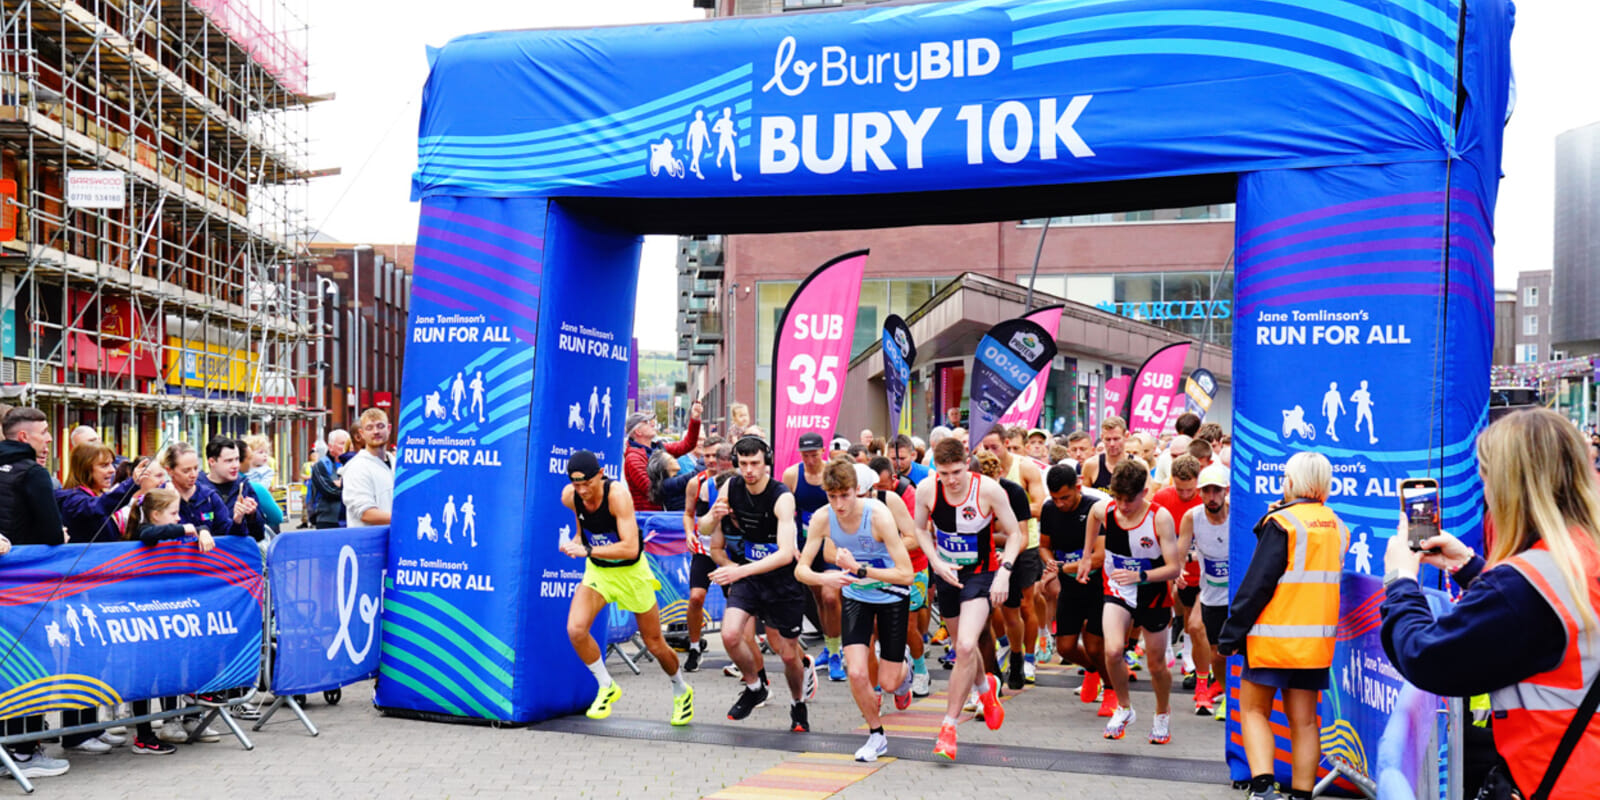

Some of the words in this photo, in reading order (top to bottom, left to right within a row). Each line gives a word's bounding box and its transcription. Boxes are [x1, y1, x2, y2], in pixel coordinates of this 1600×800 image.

[822, 37, 1001, 92] BuryBID
[759, 107, 943, 175] BURY
[956, 94, 1097, 165] 10K
[416, 315, 435, 324] Jane
[437, 314, 486, 324] Tomlinson's
[1122, 300, 1231, 320] BARCLAYS
[1257, 310, 1288, 322] Jane
[1291, 309, 1369, 322] Tomlinson's
[413, 327, 446, 343] RUN
[448, 326, 479, 342] FOR
[482, 326, 511, 342] ALL
[561, 321, 578, 333] Jane
[579, 324, 614, 341] Tomlinson's
[793, 313, 844, 340] SUB
[1256, 325, 1306, 346] RUN
[1312, 325, 1360, 345] FOR
[1366, 324, 1412, 345] ALL
[559, 333, 586, 354] RUN
[587, 339, 610, 358] FOR
[611, 344, 628, 362] ALL
[984, 346, 1031, 385] 00:40
[787, 353, 839, 405] 35
[1142, 372, 1174, 389] SUB
[1134, 394, 1170, 424] 45
[406, 435, 425, 446] Jane
[427, 436, 476, 446] Tomlinson's
[550, 444, 568, 456] Jane
[404, 448, 436, 464] RUN
[439, 449, 469, 465] FOR
[472, 449, 502, 466] ALL
[549, 457, 568, 475] RU
[1255, 475, 1285, 495] RU
[1328, 477, 1358, 497] OR
[398, 557, 418, 567] Jane
[420, 558, 469, 571] Tomlinson's
[542, 569, 558, 579] Jane
[396, 569, 428, 587] RUN
[431, 572, 462, 589] FOR
[465, 574, 495, 592] ALL
[540, 581, 567, 598] RUN
[98, 602, 131, 614] Jane
[128, 597, 201, 613] Tomlinson's
[106, 616, 160, 644] RUN
[159, 613, 203, 639] FOR
[207, 611, 239, 636] ALL
[1364, 676, 1385, 713] RUN
